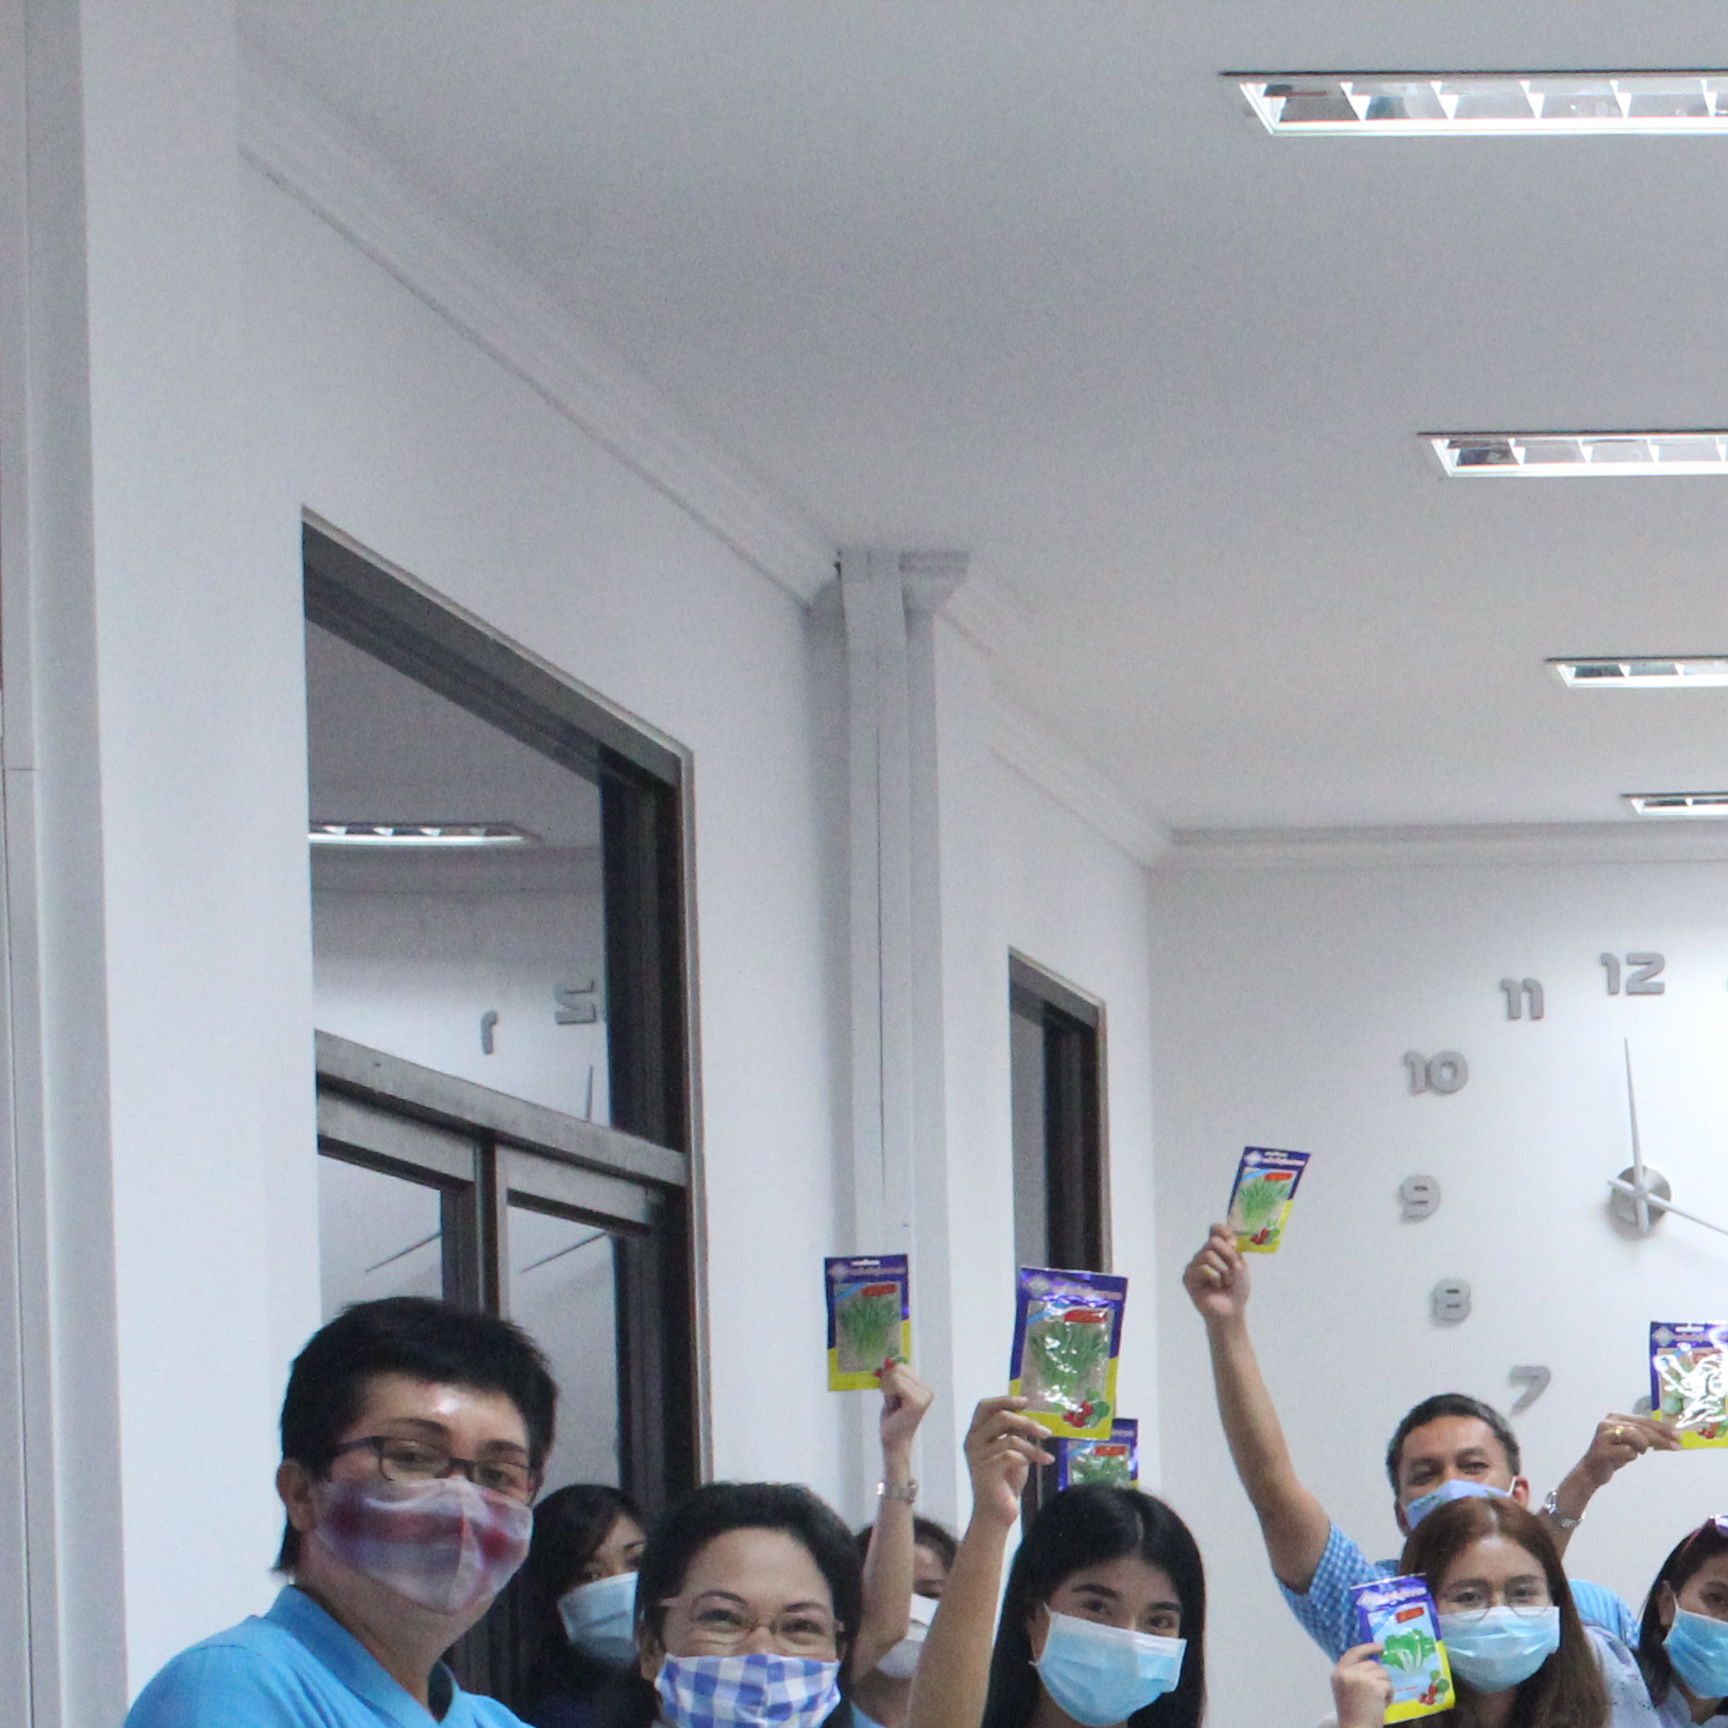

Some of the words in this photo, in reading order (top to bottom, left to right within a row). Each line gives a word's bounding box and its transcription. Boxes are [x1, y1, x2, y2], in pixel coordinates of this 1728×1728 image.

[1600, 952, 1665, 996] 12
[1500, 977, 1544, 1020] 11
[1404, 1050, 1468, 1094] 10
[1400, 1174, 1441, 1221] 9
[1431, 1278, 1472, 1326] 8
[1508, 1365, 1552, 1415] 7
